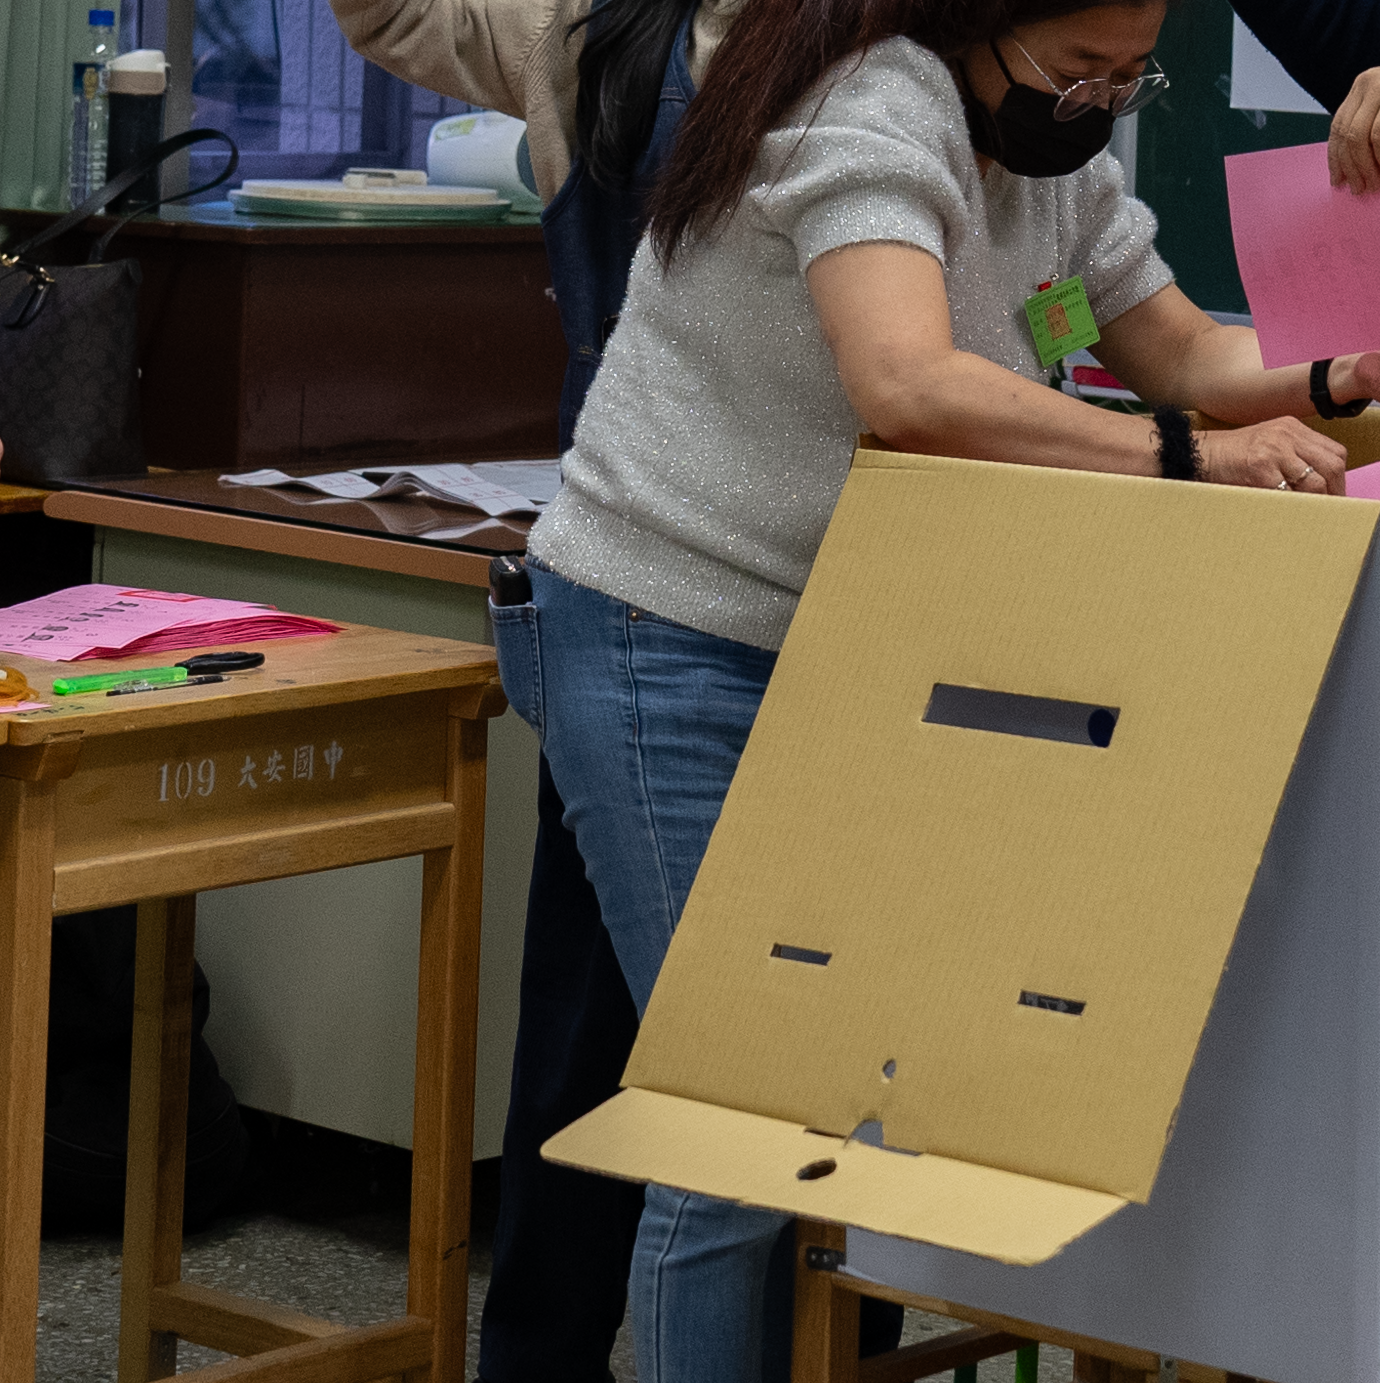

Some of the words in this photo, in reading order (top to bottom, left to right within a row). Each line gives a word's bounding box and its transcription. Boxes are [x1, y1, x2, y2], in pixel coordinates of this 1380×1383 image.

[158, 758, 215, 803] 109
[237, 740, 344, 789] 大安國中
